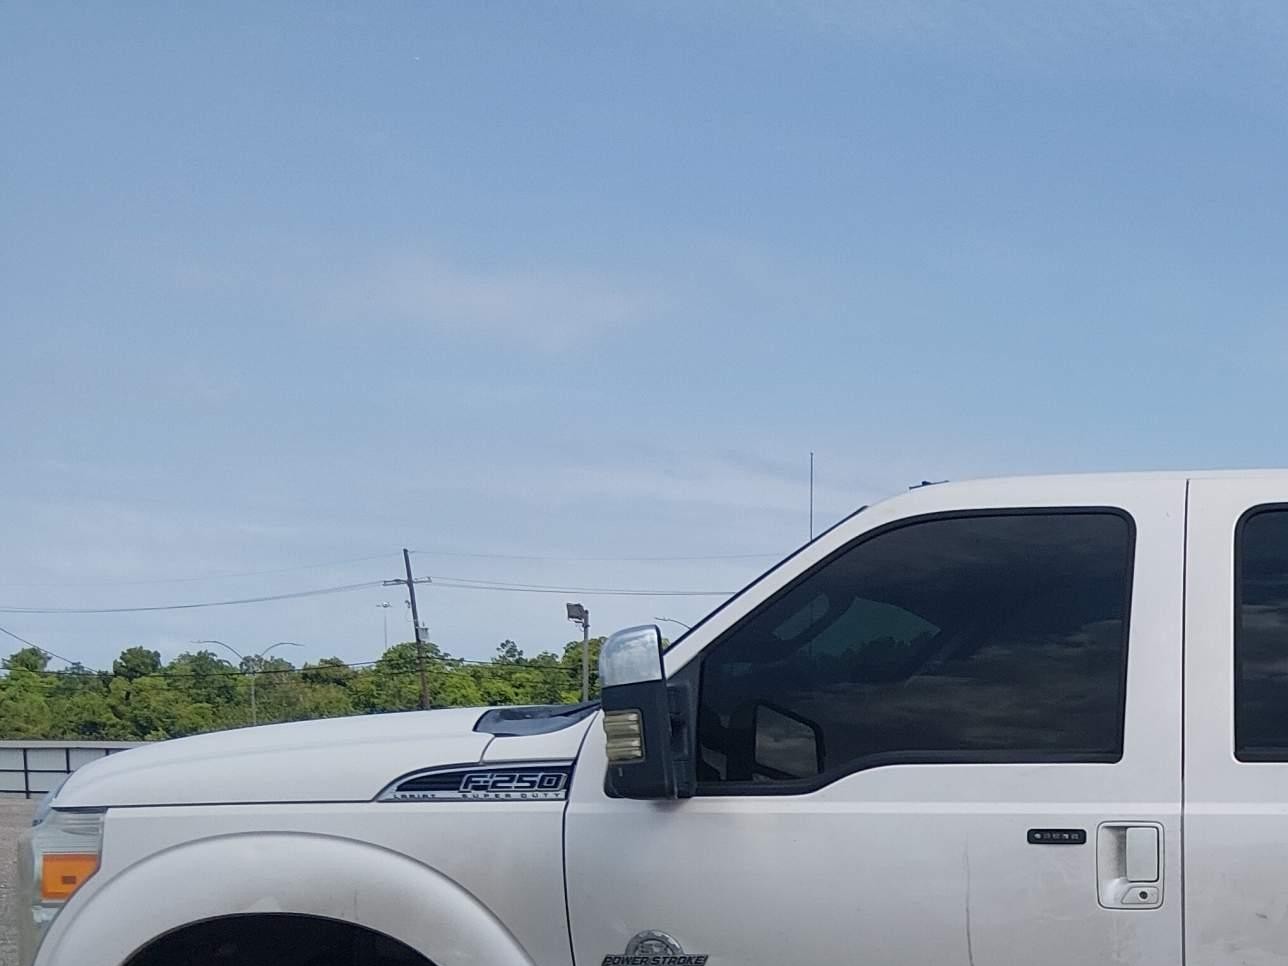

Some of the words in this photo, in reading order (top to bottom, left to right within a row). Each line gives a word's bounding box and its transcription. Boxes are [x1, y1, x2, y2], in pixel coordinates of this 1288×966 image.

[458, 772, 568, 793] F-250
[602, 955, 649, 966] POWER
[649, 955, 705, 966] STROKE
